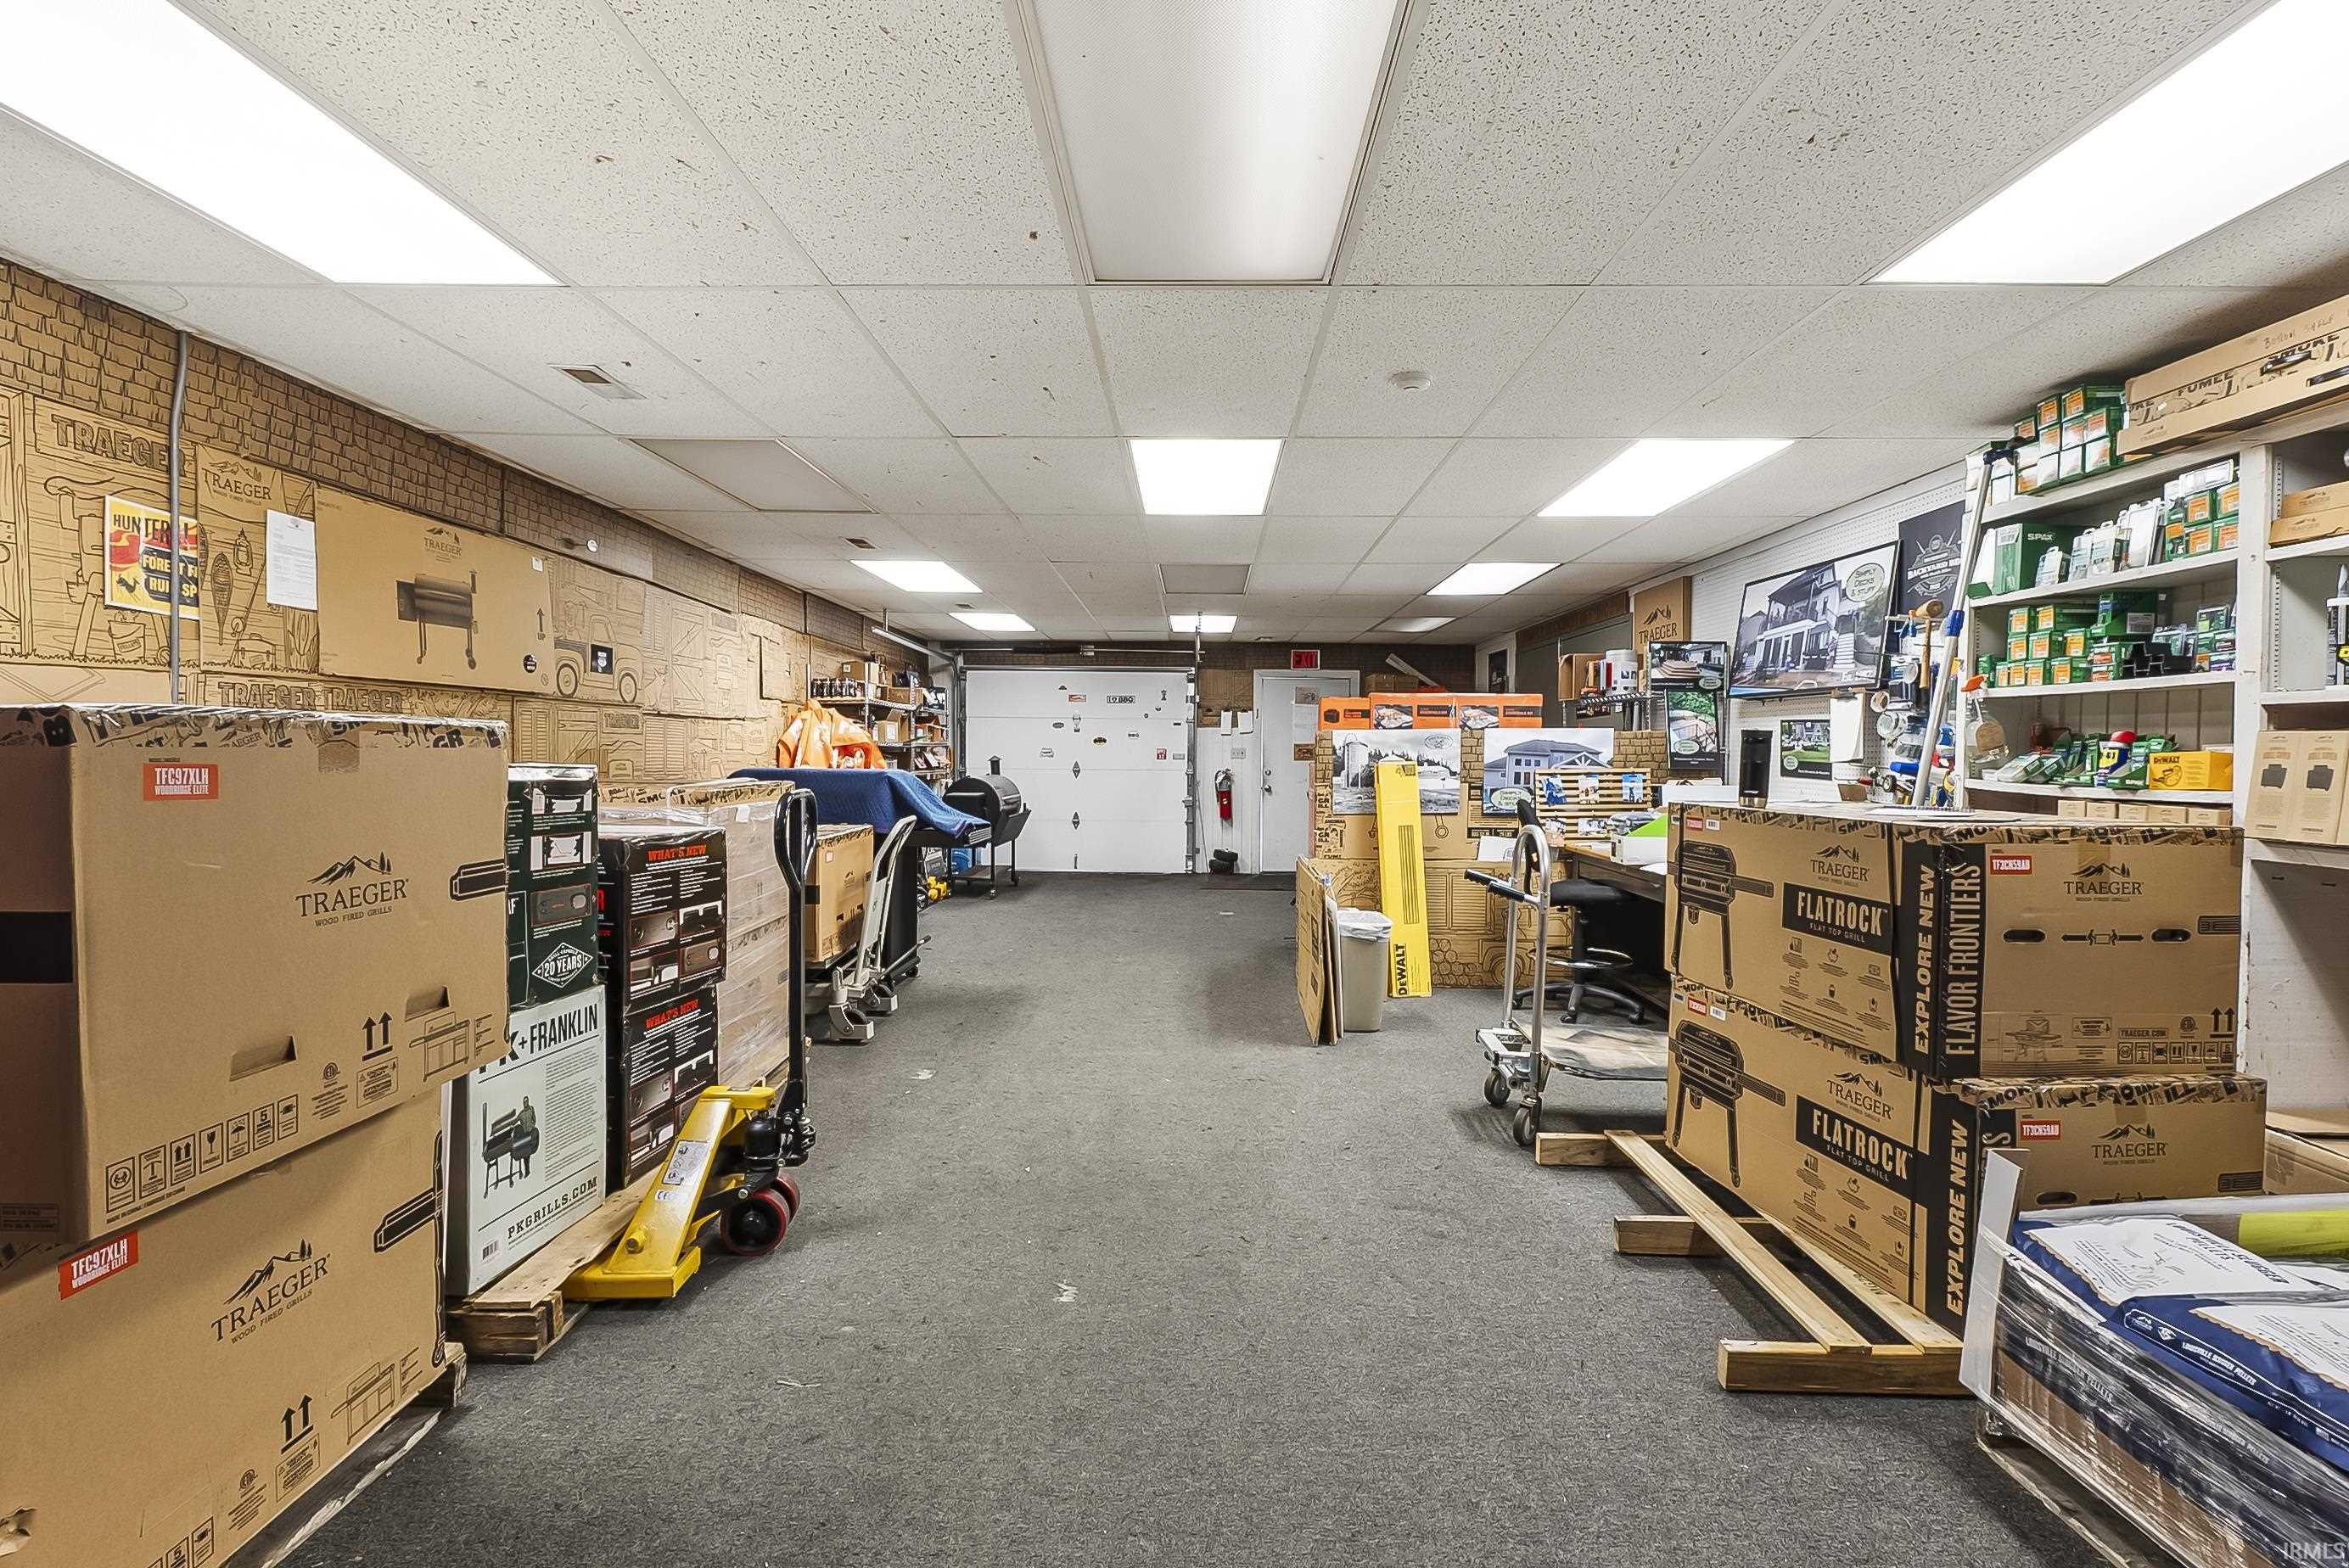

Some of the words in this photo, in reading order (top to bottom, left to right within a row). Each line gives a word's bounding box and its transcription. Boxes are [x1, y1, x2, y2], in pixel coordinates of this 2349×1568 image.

[202, 468, 272, 501] TRAEGER
[113, 514, 189, 542] HUNTER!
[424, 536, 462, 557] TRAEGER
[143, 554, 183, 576] FORET
[1639, 623, 1677, 644] TRAEGER
[1293, 652, 1316, 668] EXIT
[218, 681, 316, 711] TRAEGER
[324, 686, 403, 713] TRAEGER
[154, 767, 209, 785] TFC97XLH
[648, 848, 684, 861] WHAT'S
[1810, 860, 1869, 882] TRAEGER
[295, 879, 408, 917] TRAEGER
[1919, 865, 1935, 927] NEW
[2063, 881, 2143, 895] TRAEGER
[315, 916, 339, 927] WOOD
[342, 911, 364, 922] FIRED
[367, 905, 392, 916] GRILLS
[1797, 891, 1881, 937] FLATROCK
[1948, 864, 1981, 976] FRONTIERS
[1828, 927, 1842, 937] TOP
[1843, 931, 1865, 943] GRILL
[544, 960, 556, 977] 20
[556, 954, 582, 974] YEARS
[1396, 943, 1408, 996] DEWALT
[1915, 932, 1932, 1054] EXPLORE
[1946, 982, 1977, 1055] FLAVOR
[260, 1109, 268, 1122] 5
[1826, 1079, 1892, 1120] TRAEGER
[1812, 1108, 1909, 1179] FLATROCK
[1950, 1119, 1969, 1187] NEW
[2091, 1143, 2167, 1159] TRAEGER
[1847, 1154, 1863, 1168] TOP
[1865, 1163, 1889, 1182] GRILL
[507, 1176, 597, 1239] PKGRILLS.COM
[71, 1239, 127, 1279] TFC97XLH
[1947, 1189, 1965, 1317] EXPLORE
[210, 1257, 328, 1341] TRAEGER
[231, 1324, 256, 1344] WOOD
[260, 1308, 283, 1326] FIRED
[286, 1288, 312, 1310] GRILLS
